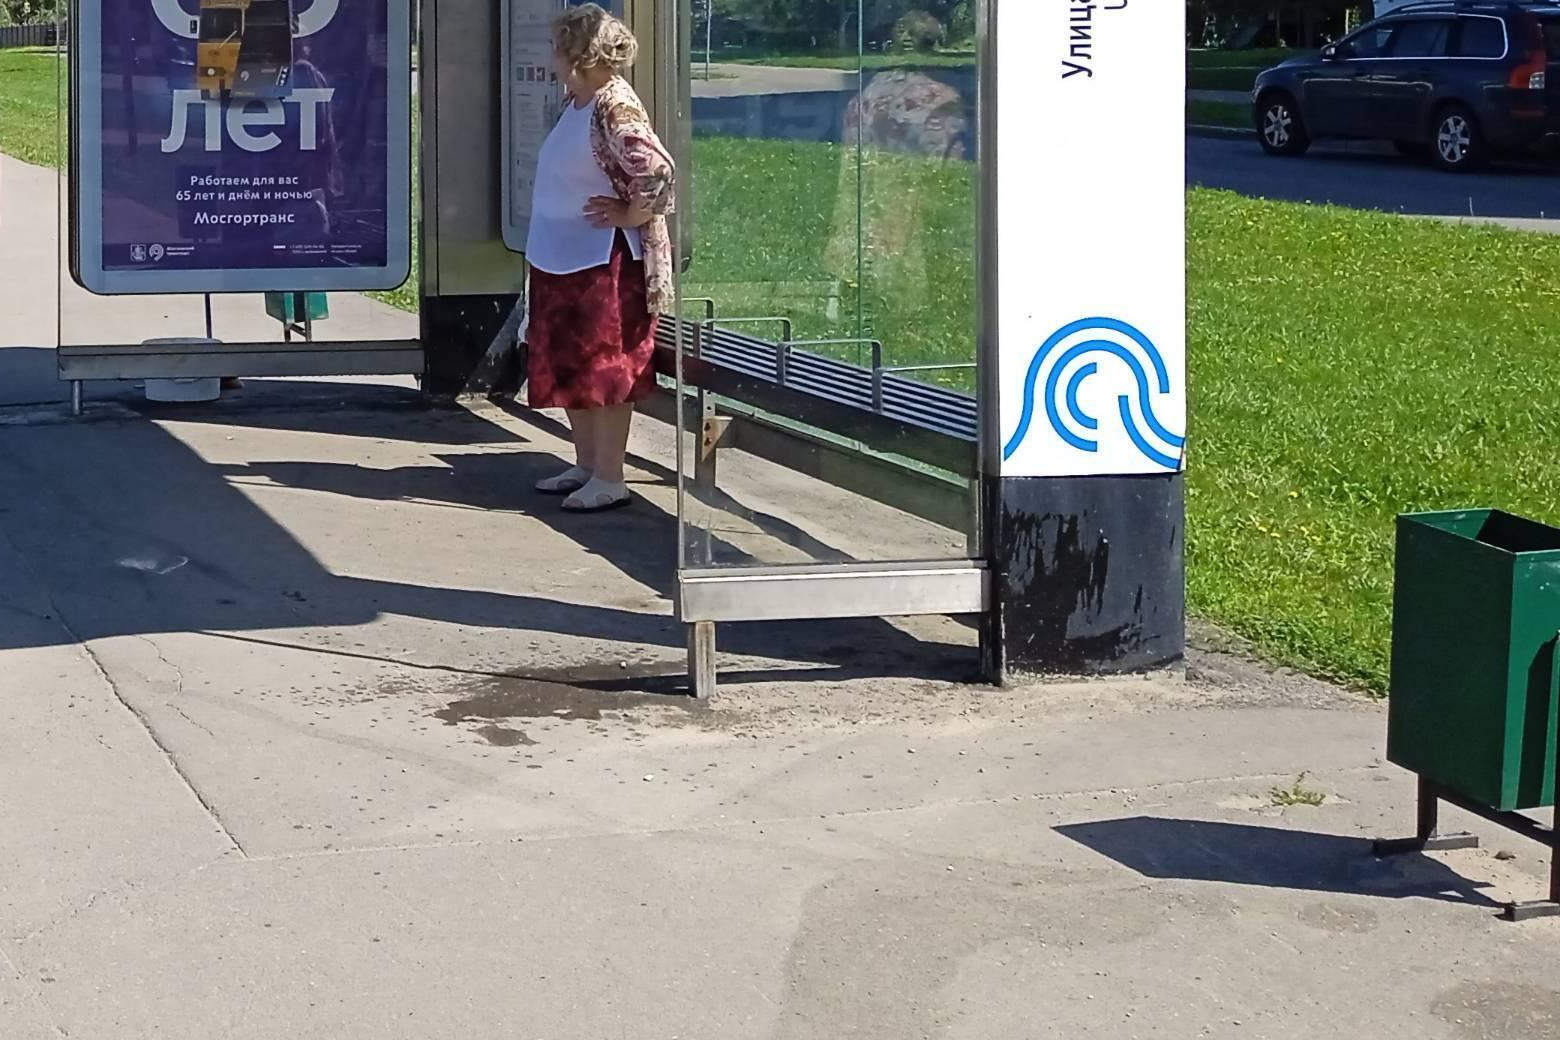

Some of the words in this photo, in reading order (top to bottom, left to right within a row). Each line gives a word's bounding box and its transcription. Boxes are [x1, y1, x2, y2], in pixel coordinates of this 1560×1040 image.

[161, 87, 335, 153] лет
[190, 176, 250, 186] Работаем
[253, 177, 275, 187] для
[278, 176, 299, 185] вас
[176, 191, 191, 201] 65
[194, 192, 215, 201] лет
[218, 192, 226, 201] и
[228, 190, 261, 202] днём
[263, 191, 272, 200] и
[274, 190, 313, 200] ночью
[193, 212, 295, 227] Мосгортранс
